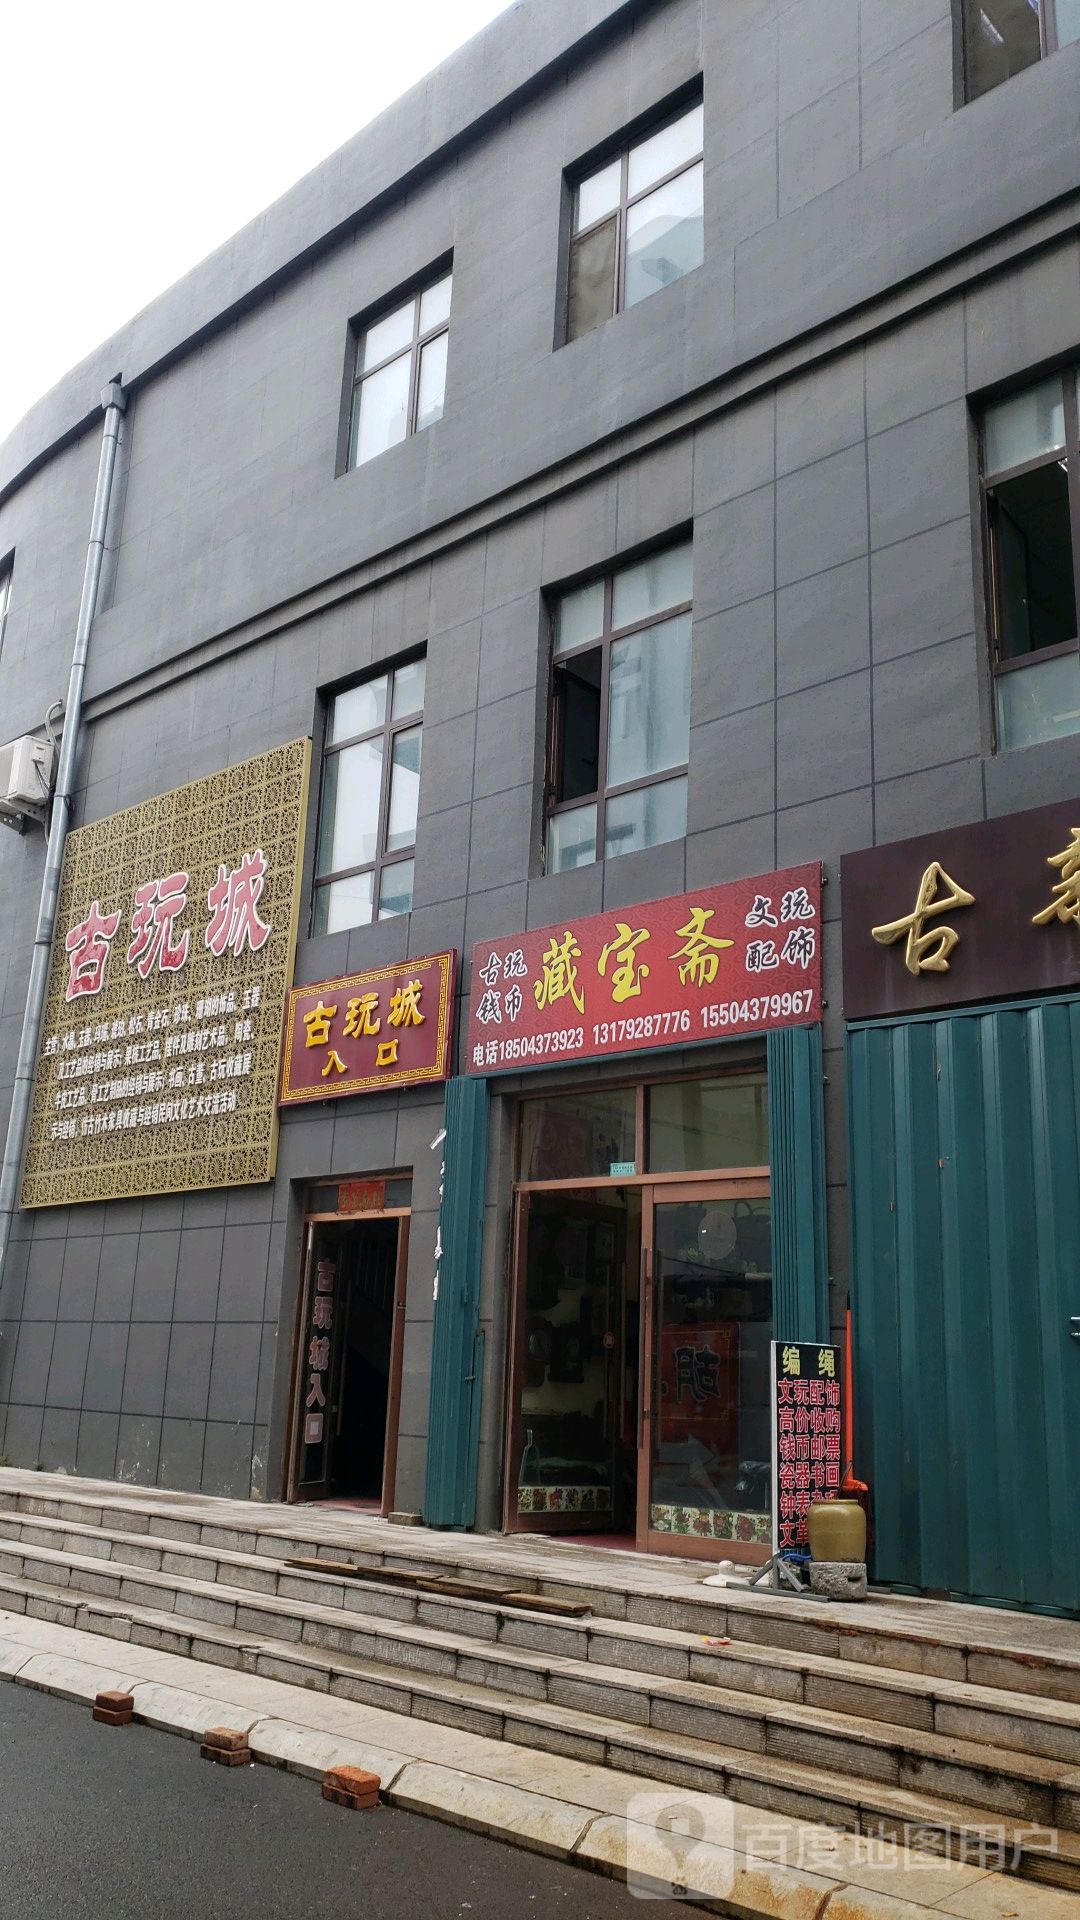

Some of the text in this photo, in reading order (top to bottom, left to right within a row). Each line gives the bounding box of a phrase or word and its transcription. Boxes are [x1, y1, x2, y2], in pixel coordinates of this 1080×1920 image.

[64, 848, 270, 1002] 古玩城
[745, 886, 816, 929] 文玩
[479, 949, 528, 987] 古玩
[533, 907, 735, 1014] 藏宝斋
[745, 926, 816, 973] 配饰
[303, 979, 426, 1048] 古玩城
[476, 985, 524, 1024] 钱币
[592, 1009, 691, 1046] 13179287776
[700, 989, 814, 1028] 15504379967
[321, 1039, 399, 1077] 入口
[305, 1261, 336, 1444] 古玩城入口
[782, 1345, 836, 1377] 编绳
[778, 1379, 841, 1406] 文玩配饰
[779, 1406, 841, 1433] 高价收购
[779, 1434, 841, 1461] 钱币邮票
[779, 1461, 840, 1488] 瓷器书画
